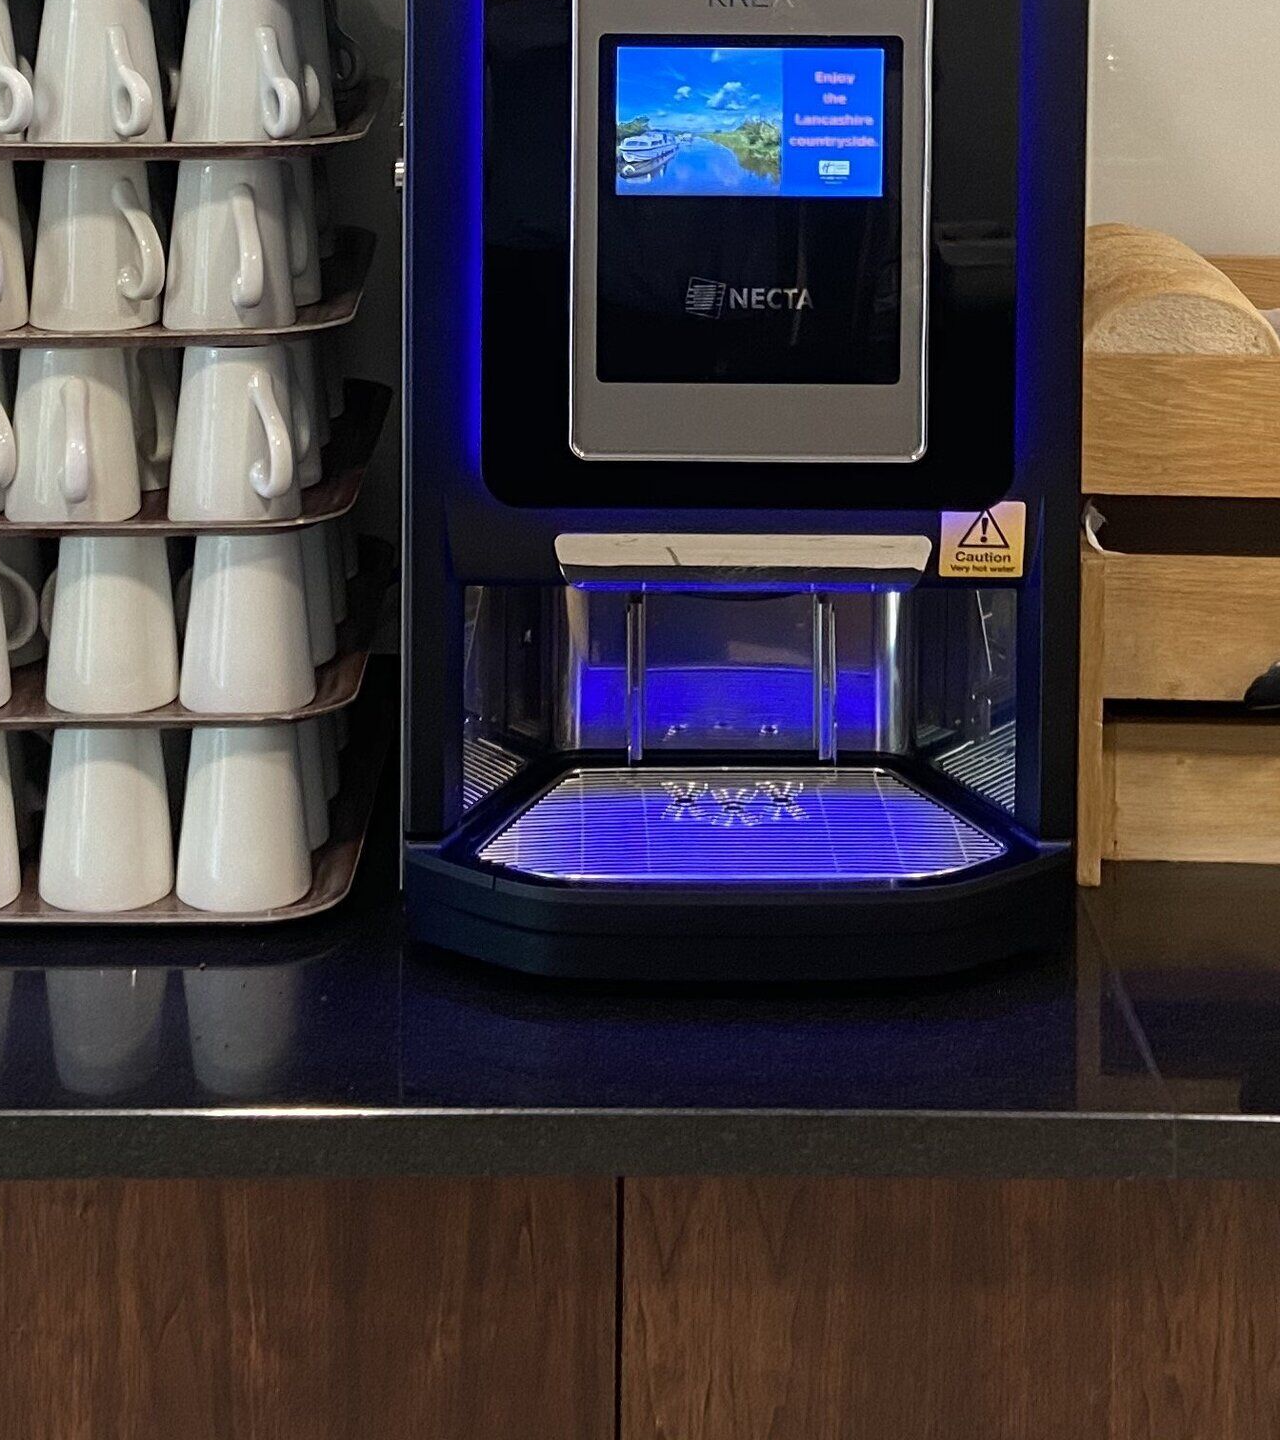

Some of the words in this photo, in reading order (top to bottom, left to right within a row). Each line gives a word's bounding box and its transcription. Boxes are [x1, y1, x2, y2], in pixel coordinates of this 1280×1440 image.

[822, 92, 848, 105] the
[729, 287, 813, 310] NECTA
[955, 550, 1012, 563] Caution
[950, 564, 970, 573] Very
[989, 565, 1015, 573] water
